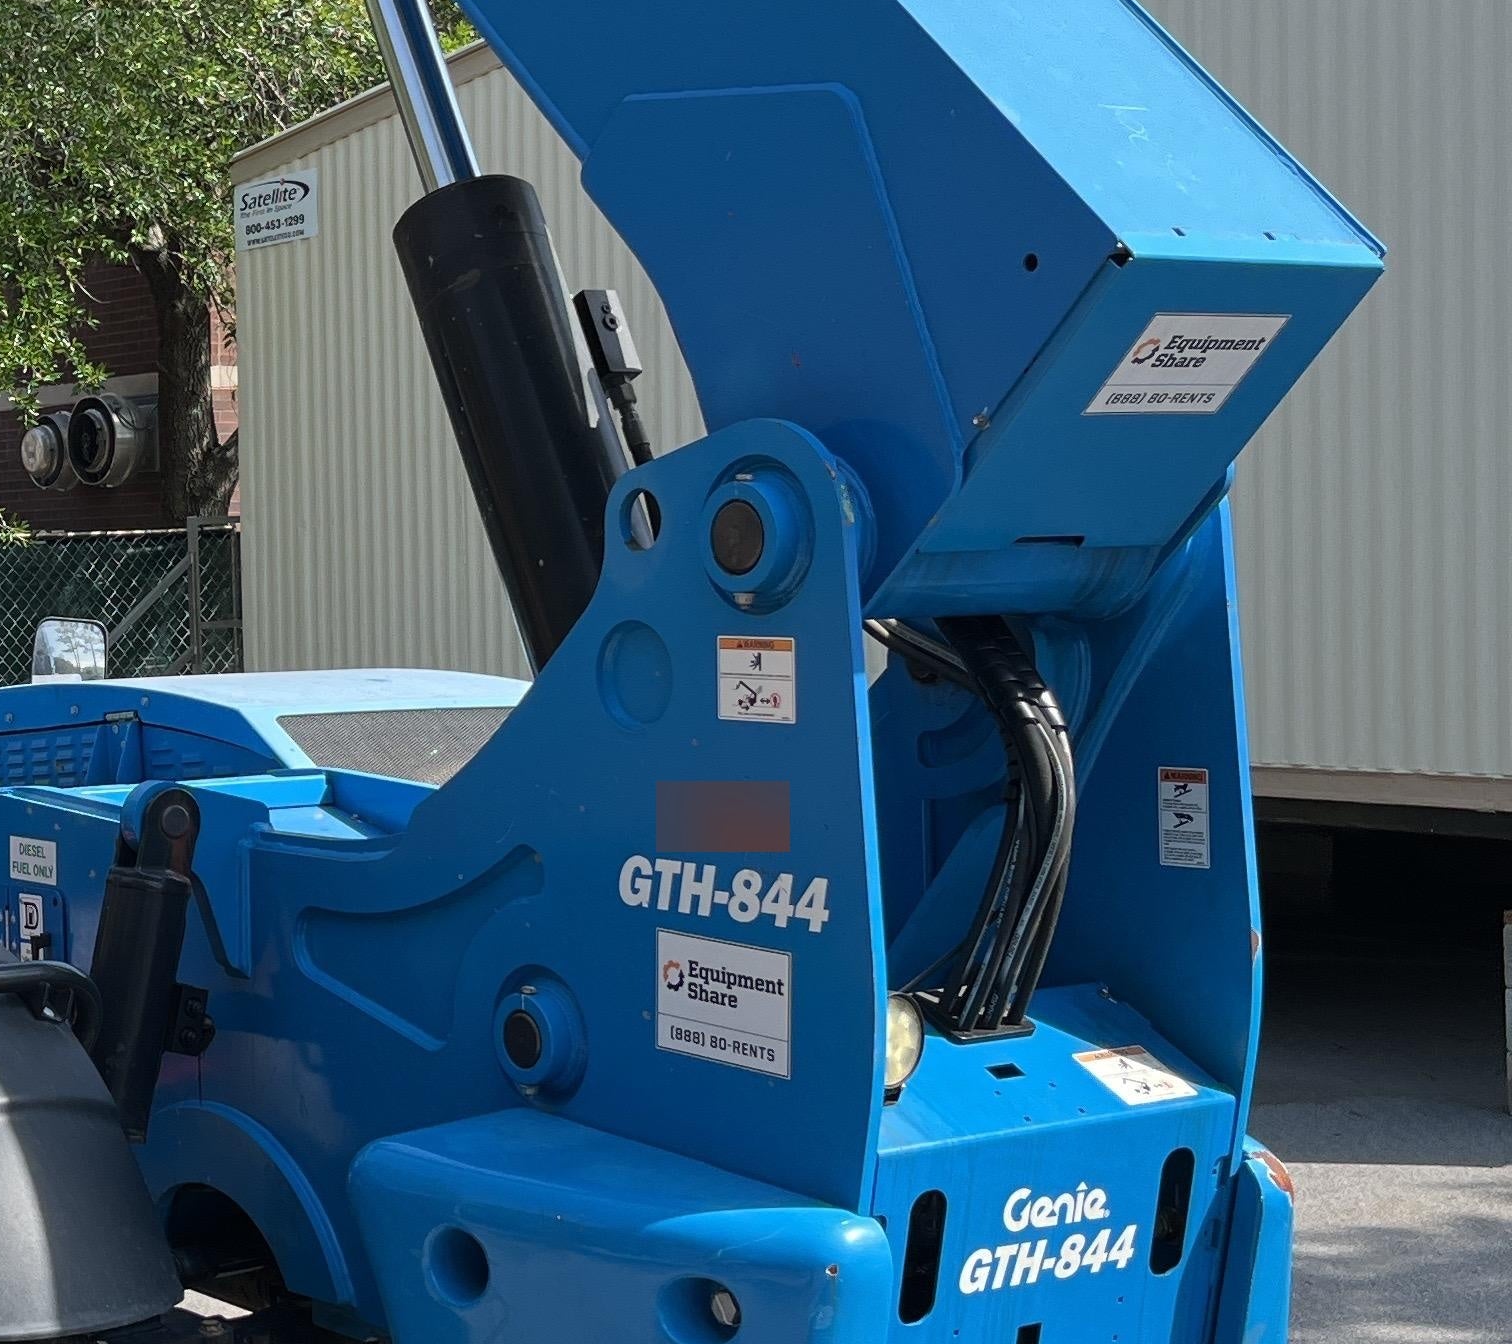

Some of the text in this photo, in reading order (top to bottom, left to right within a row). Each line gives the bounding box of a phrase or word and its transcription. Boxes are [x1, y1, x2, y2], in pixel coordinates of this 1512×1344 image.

[240, 187, 297, 211] Satellite
[1164, 335, 1266, 354] Equipment
[1151, 354, 1206, 368] Share
[1105, 393, 1215, 405] (888) 80-RENTS
[19, 843, 46, 859] DIESEL
[12, 860, 54, 879] FUEL ONLY
[618, 855, 830, 933] GTH-844
[688, 960, 785, 996] Equipment
[688, 982, 738, 1008] Share
[670, 1025, 775, 1062] (888) 80-RENTS
[1003, 1181, 1111, 1232] Genie
[958, 1224, 1137, 1294] GTH-844
